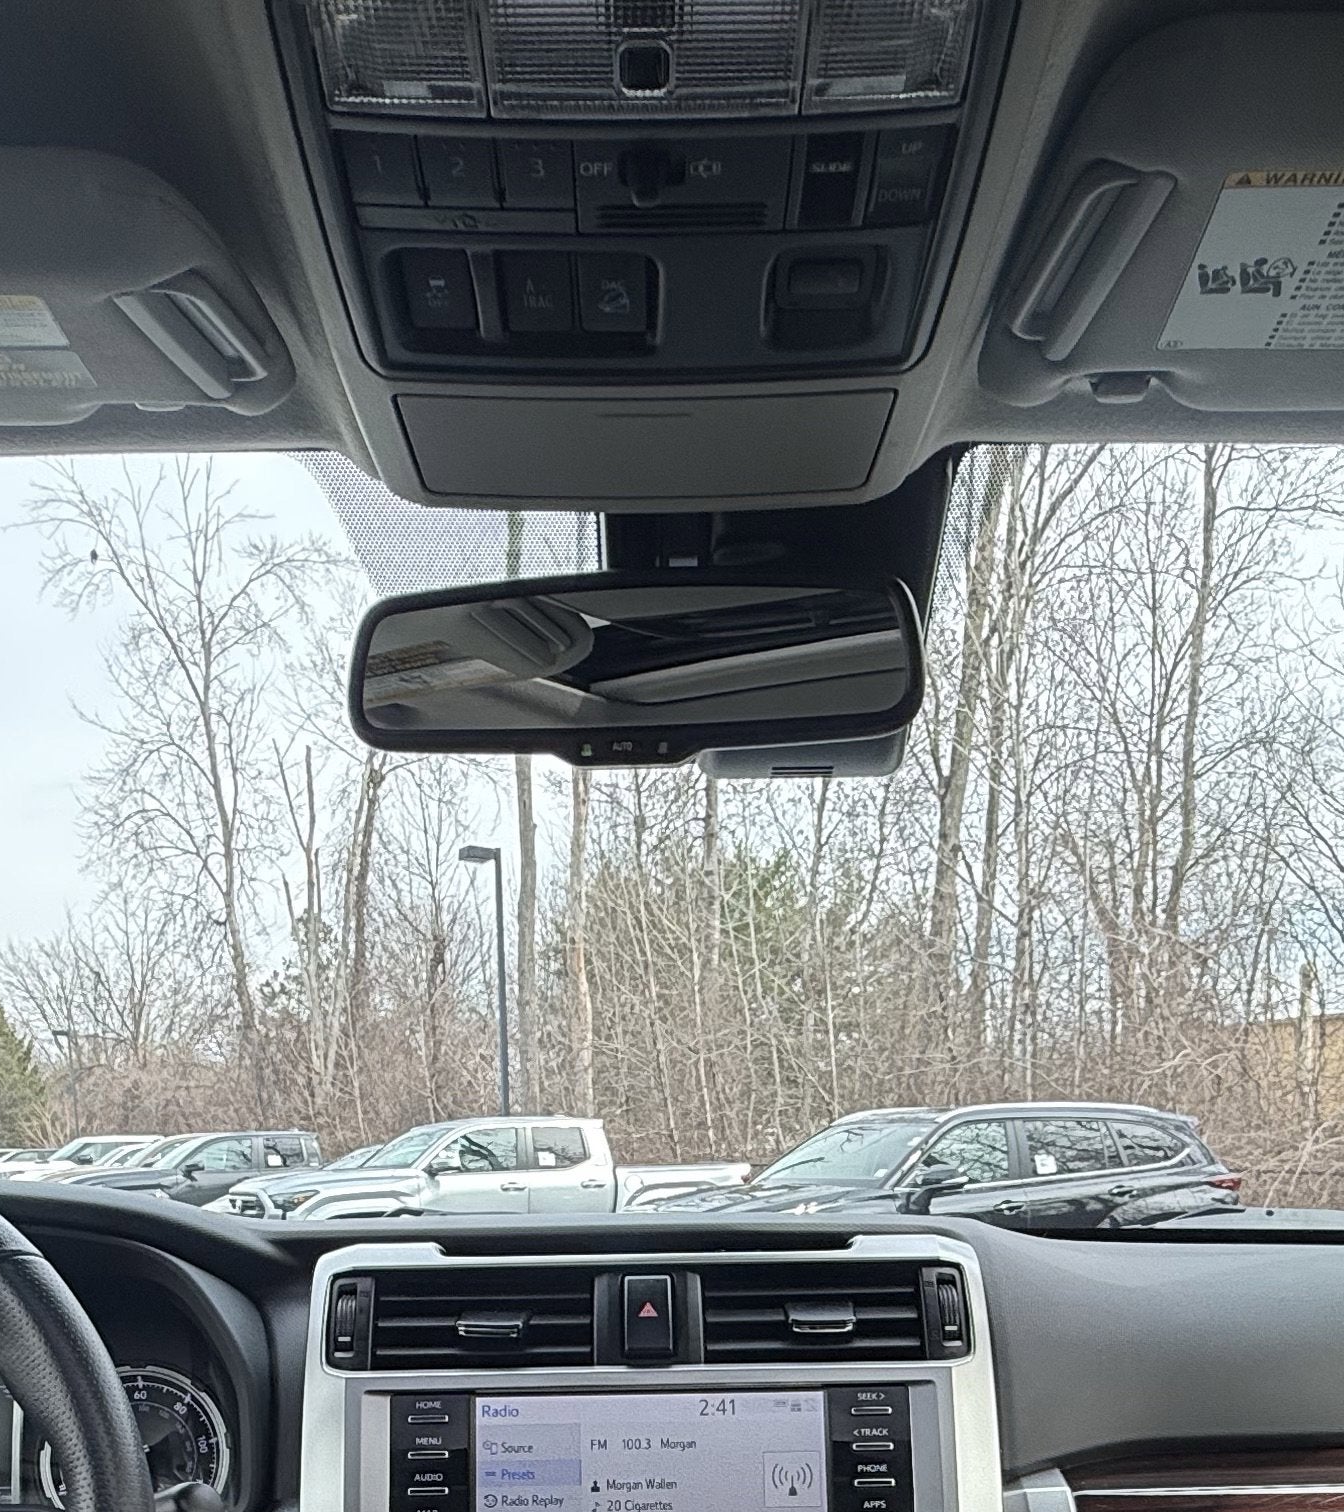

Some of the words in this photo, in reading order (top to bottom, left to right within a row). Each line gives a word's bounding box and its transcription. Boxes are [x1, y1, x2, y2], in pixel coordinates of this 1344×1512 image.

[902, 142, 924, 154] UP
[452, 157, 465, 177] 2
[531, 158, 545, 177] 3
[579, 162, 613, 176] OFF
[809, 162, 852, 173] SLIDE
[877, 189, 921, 201] DOWN
[133, 1391, 147, 1400] 60
[173, 1402, 187, 1415] 80
[415, 1401, 442, 1409] HOME
[481, 1404, 520, 1418] Radio
[699, 1399, 736, 1416] 2:41
[860, 1428, 889, 1436] TRACK
[197, 1435, 208, 1453] 100
[415, 1437, 442, 1445] MENU
[590, 1438, 607, 1450] FM
[622, 1438, 652, 1450] 100.3
[660, 1438, 697, 1452] Morgan
[500, 1442, 534, 1454] Source
[500, 1468, 536, 1480] Presets
[857, 1464, 887, 1473] PHONE
[414, 1473, 444, 1481] AUDIO
[606, 1479, 643, 1492] Morgan
[646, 1479, 678, 1490] Wallen
[501, 1494, 528, 1507] Radio
[531, 1494, 565, 1509] Replay
[606, 1500, 622, 1511] 20
[624, 1500, 673, 1512] Cigarettes
[863, 1500, 887, 1509] APPS
